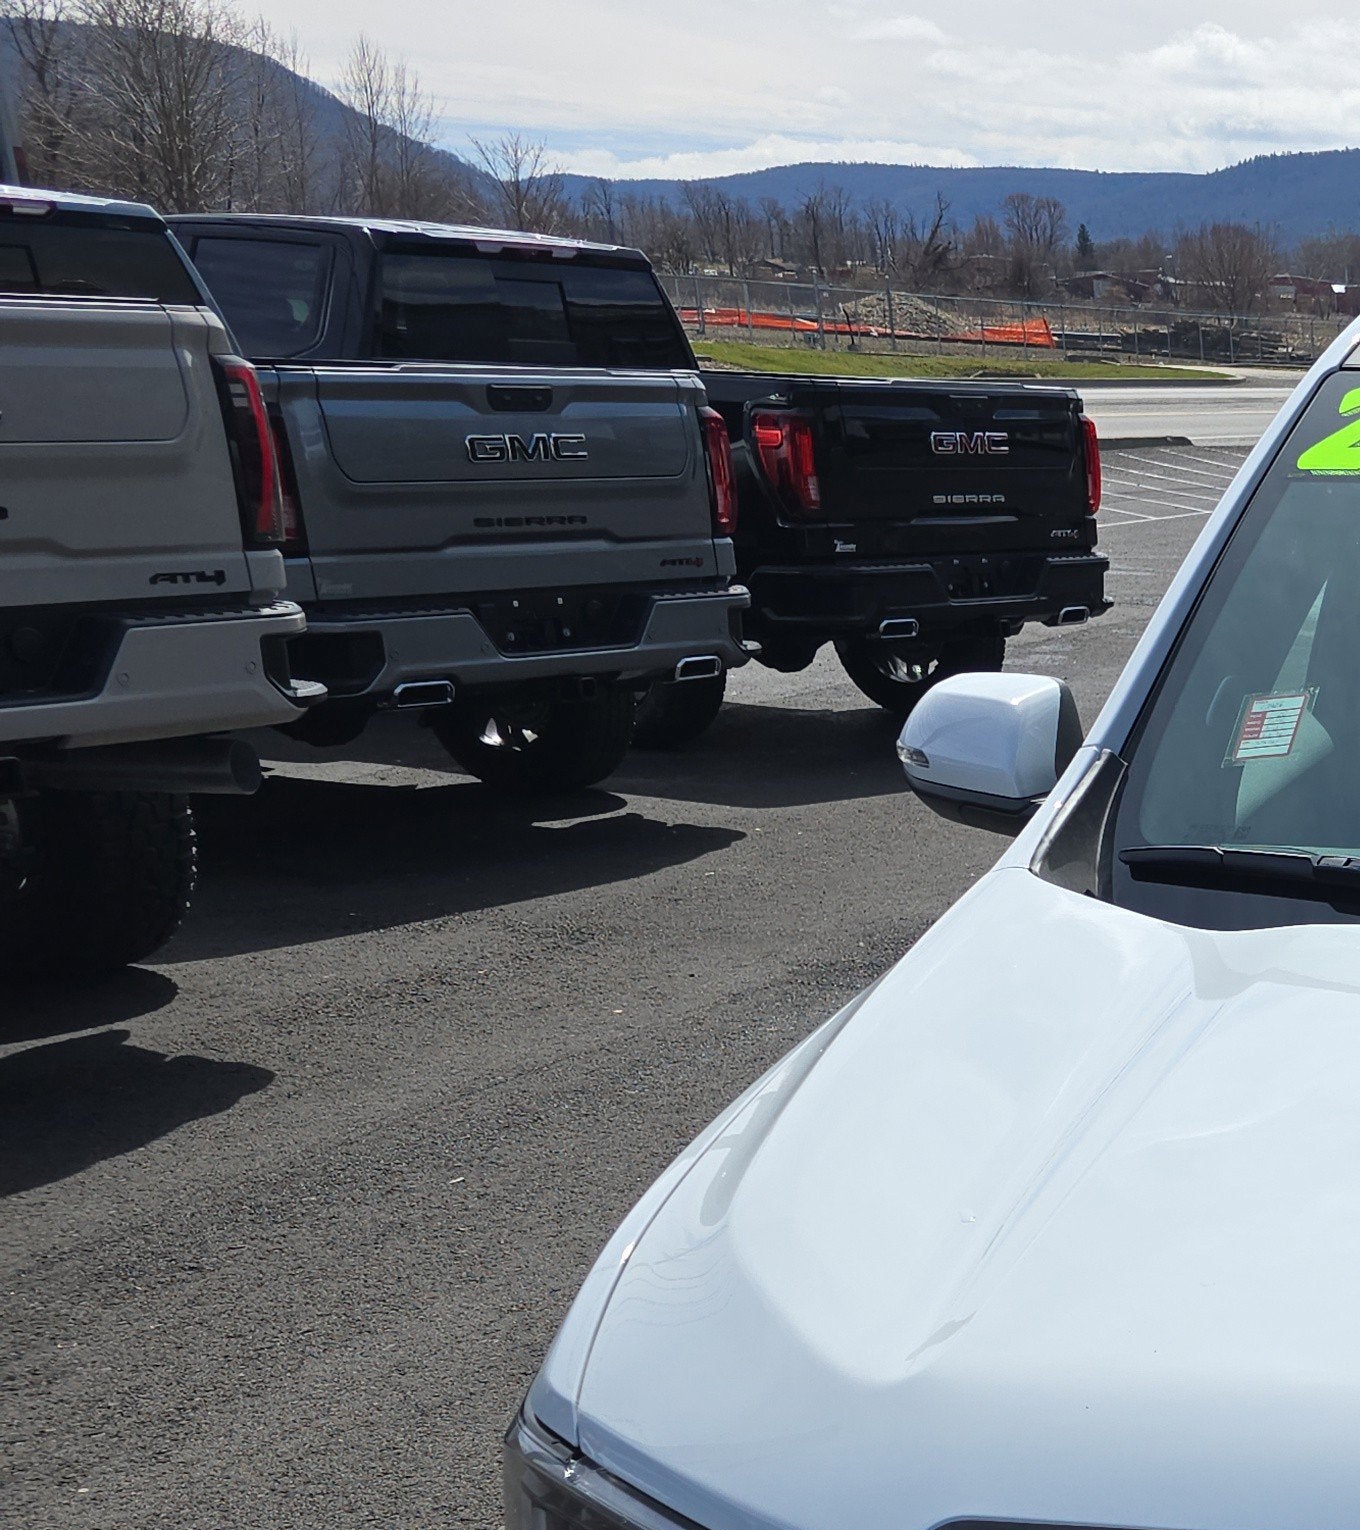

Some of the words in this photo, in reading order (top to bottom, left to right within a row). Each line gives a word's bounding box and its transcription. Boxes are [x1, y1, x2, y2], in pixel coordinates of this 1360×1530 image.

[465, 432, 588, 463] GMC
[930, 431, 1010, 455] GMC
[932, 494, 1006, 504] SIERRA
[473, 515, 588, 528] SIERRA
[659, 557, 705, 568] AT4
[149, 569, 227, 586] AT4
